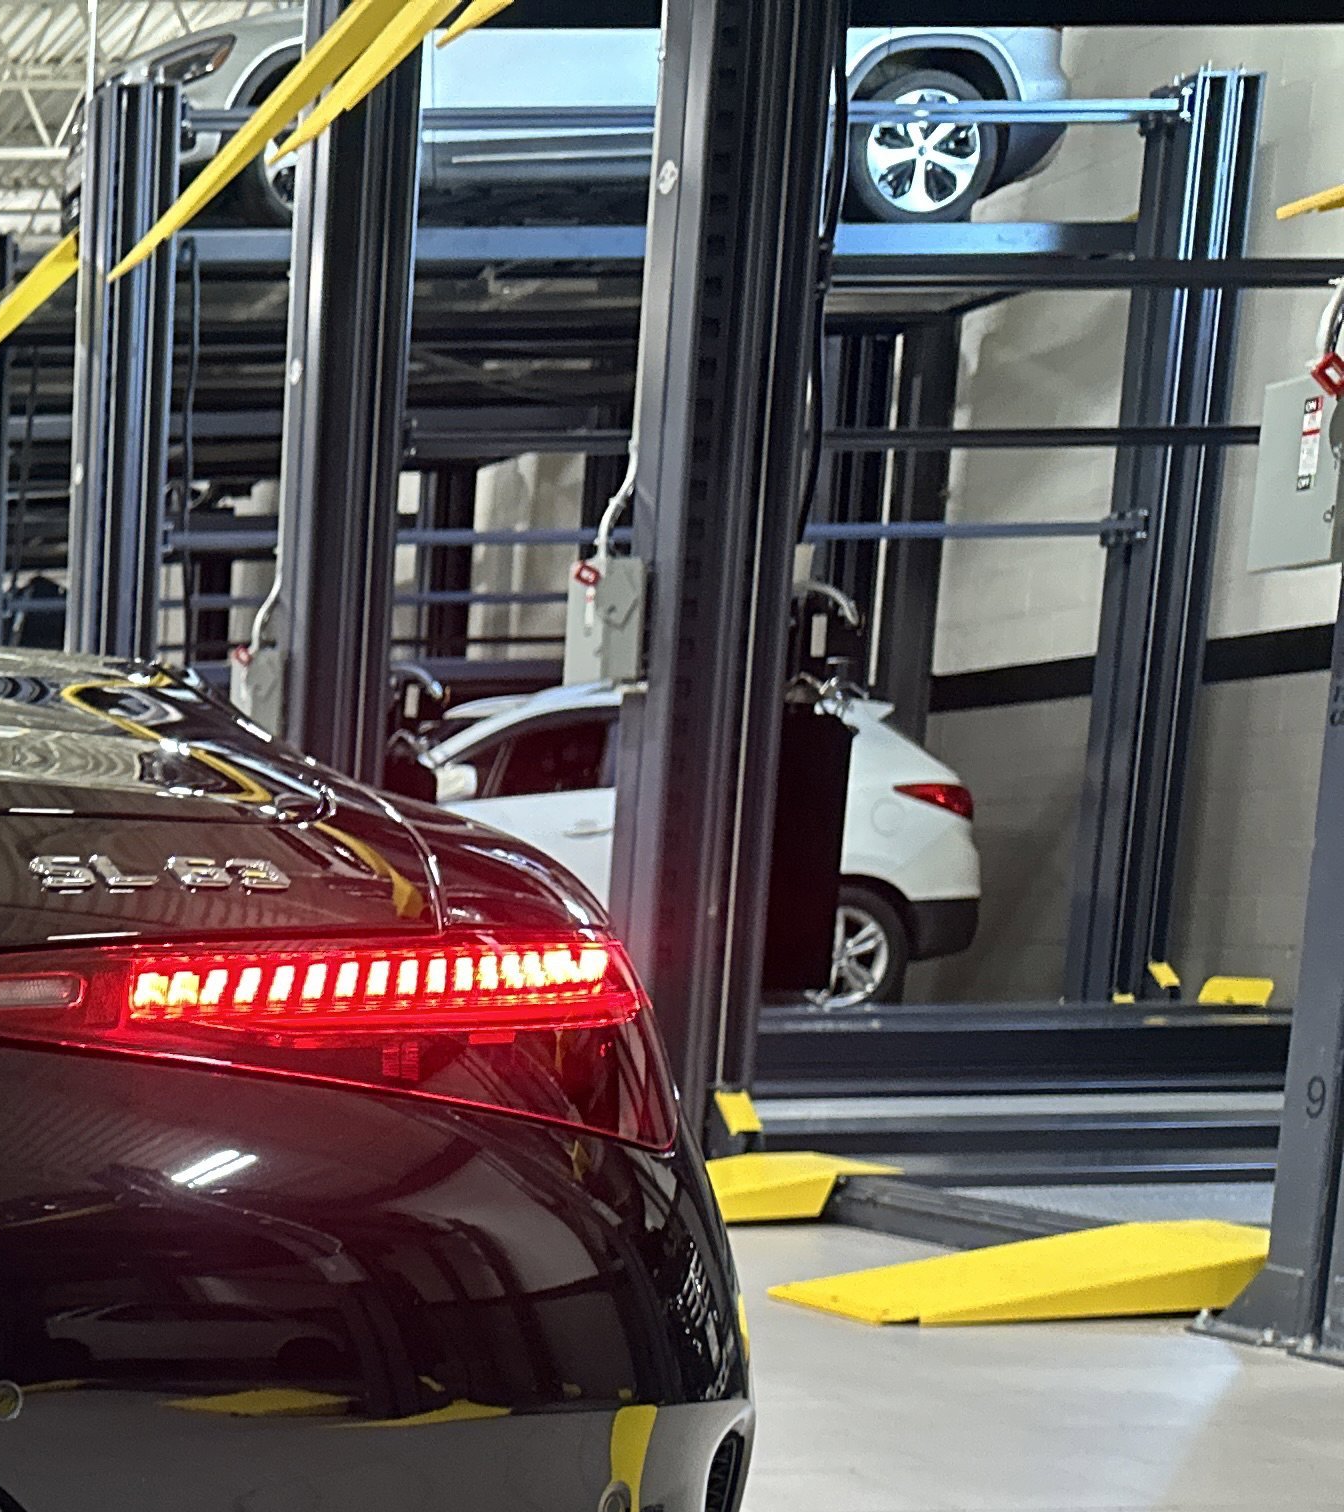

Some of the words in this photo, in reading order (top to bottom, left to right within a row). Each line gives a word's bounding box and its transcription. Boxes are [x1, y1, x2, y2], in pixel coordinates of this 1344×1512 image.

[28, 854, 160, 887] SL
[165, 855, 292, 890] 63
[1306, 1075, 1326, 1119] 9
